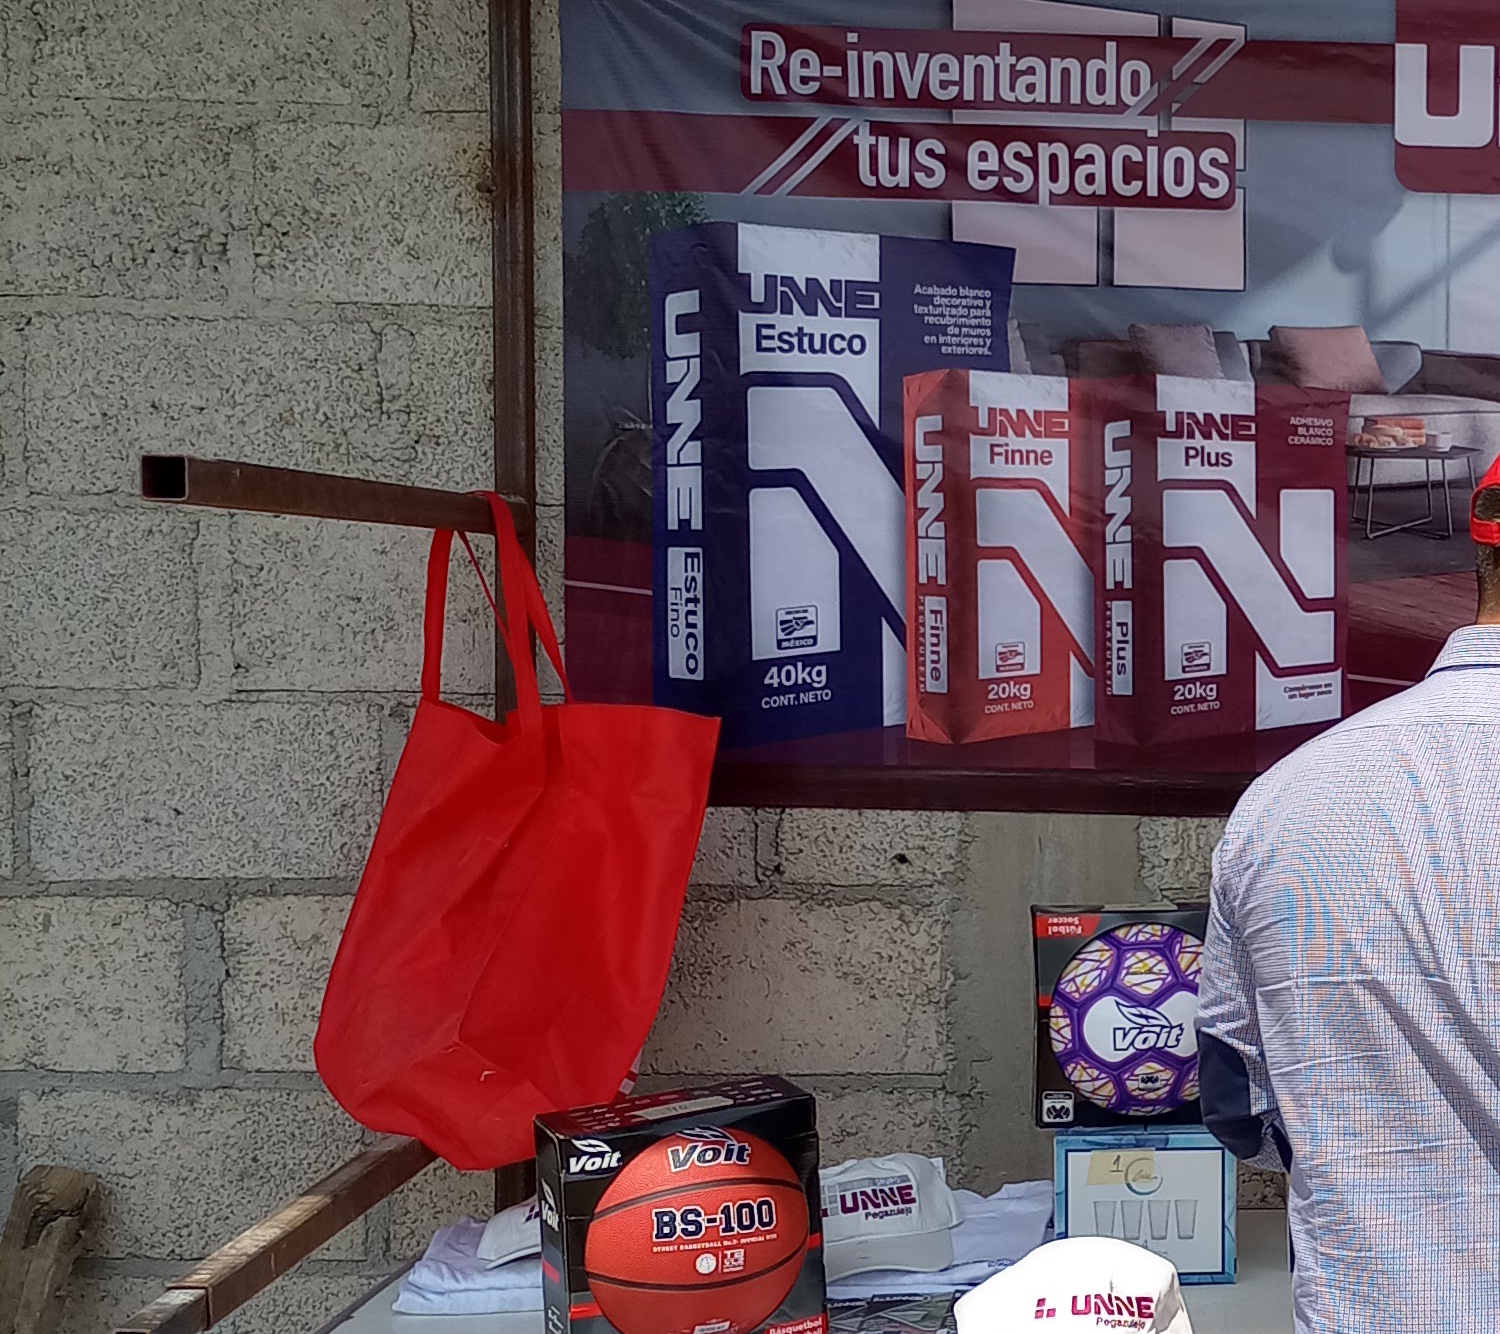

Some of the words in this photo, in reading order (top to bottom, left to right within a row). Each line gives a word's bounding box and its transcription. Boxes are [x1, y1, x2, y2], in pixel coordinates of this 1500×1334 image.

[750, 30, 1152, 108] Re-inventando
[853, 131, 946, 189] tus
[966, 125, 1231, 206] espacios
[914, 284, 958, 296] Acabado
[959, 286, 992, 298] blanco
[933, 295, 984, 307] decorativo
[985, 300, 992, 310] y
[914, 304, 968, 316] texturizado
[970, 308, 992, 318] para
[924, 316, 992, 327] recubrimiento
[755, 324, 867, 356] Estuco
[924, 335, 938, 344] en
[939, 333, 984, 346] interiores
[985, 338, 992, 348] y
[947, 326, 960, 335] de
[961, 327, 992, 337] muros
[988, 444, 1054, 466] Finne
[1184, 445, 1233, 468] Plus
[669, 586, 683, 638] Fino
[684, 551, 701, 676] Estuco
[929, 609, 945, 682] Finne
[1116, 621, 1130, 676] Plus
[763, 661, 827, 688] 40kg
[761, 693, 799, 709] CONT.
[799, 689, 832, 705] NETO
[987, 680, 1031, 700] 20kg
[1173, 681, 1217, 701] 20kg
[1011, 700, 1035, 711] NETO
[1197, 700, 1221, 712] NETO
[1112, 1020, 1184, 1052] Voit
[568, 1150, 622, 1174] Voit
[667, 1141, 751, 1173] Voit
[839, 1183, 917, 1215] UNNE
[540, 1199, 560, 1232] Voit
[651, 1196, 777, 1243] BS-100
[1071, 1293, 1155, 1320] UNNE
